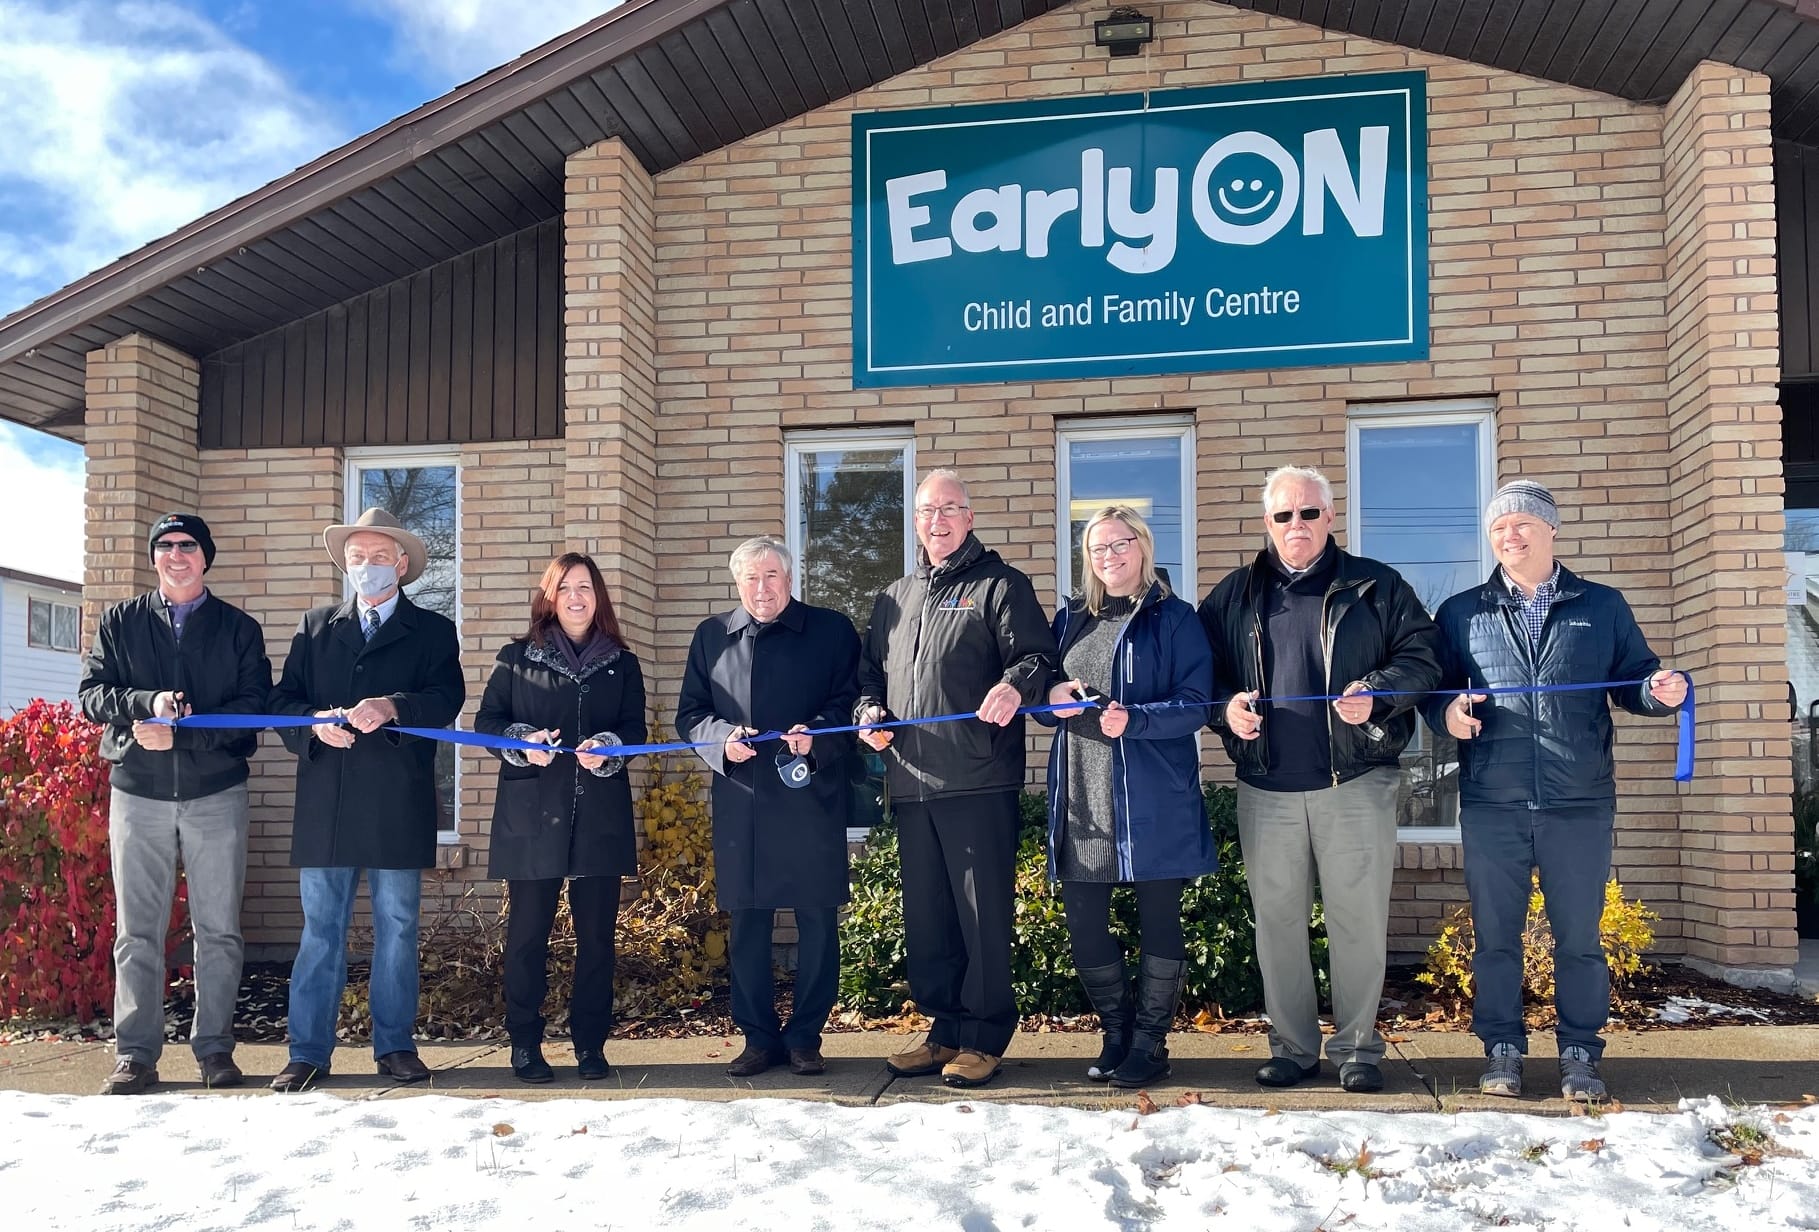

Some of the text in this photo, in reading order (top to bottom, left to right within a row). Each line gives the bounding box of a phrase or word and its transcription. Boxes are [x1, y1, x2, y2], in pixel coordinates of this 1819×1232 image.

[963, 286, 1300, 333] Child and Family Centre
